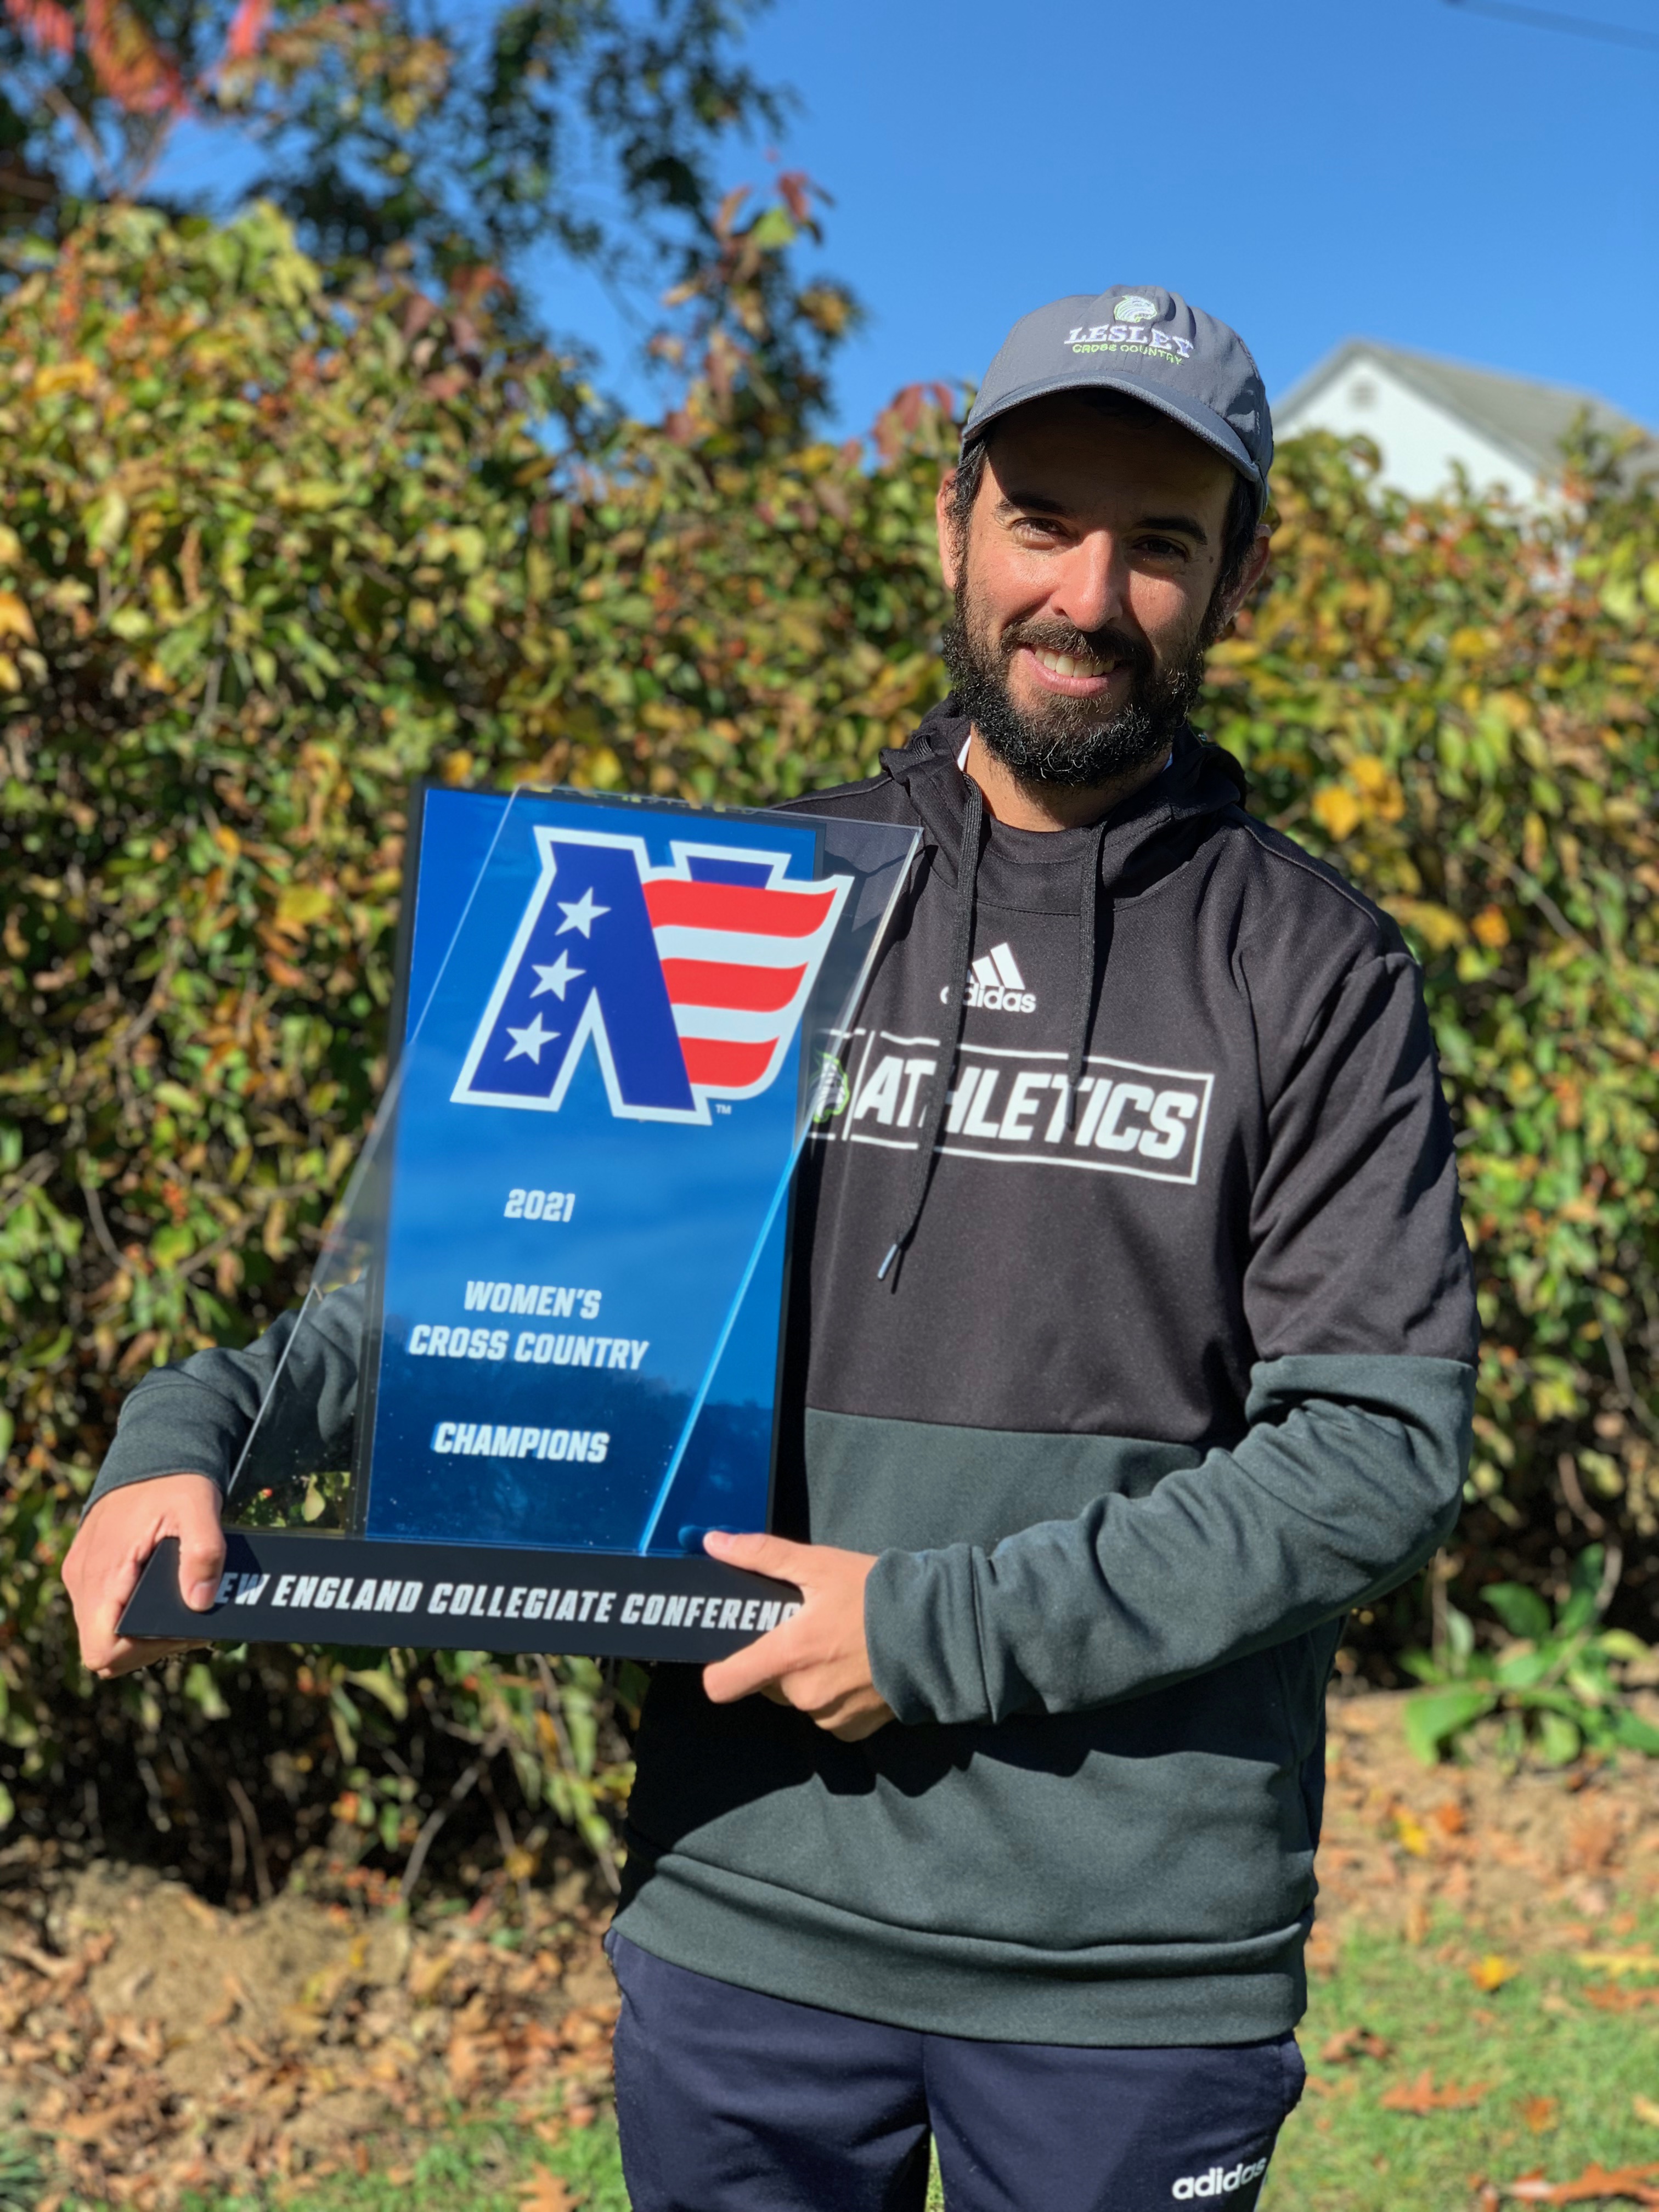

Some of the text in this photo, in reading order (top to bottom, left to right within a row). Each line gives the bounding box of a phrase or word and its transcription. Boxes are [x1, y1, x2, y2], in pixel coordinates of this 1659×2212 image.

[1064, 324, 1194, 358] LESLEY
[1072, 343, 1183, 365] CROSS COUNTRY
[715, 1104, 732, 1115] TM
[504, 1189, 575, 1222] 2021
[464, 1280, 602, 1319] WOMEN'S
[407, 1325, 650, 1369] CROSS COUNTRY
[432, 1422, 610, 1463] CHAMPIONS
[215, 1572, 270, 1605] EW
[271, 1575, 422, 1612] ENGLAND
[427, 1583, 617, 1622] COLLEGIATE
[1172, 2157, 1267, 2199] adidas
